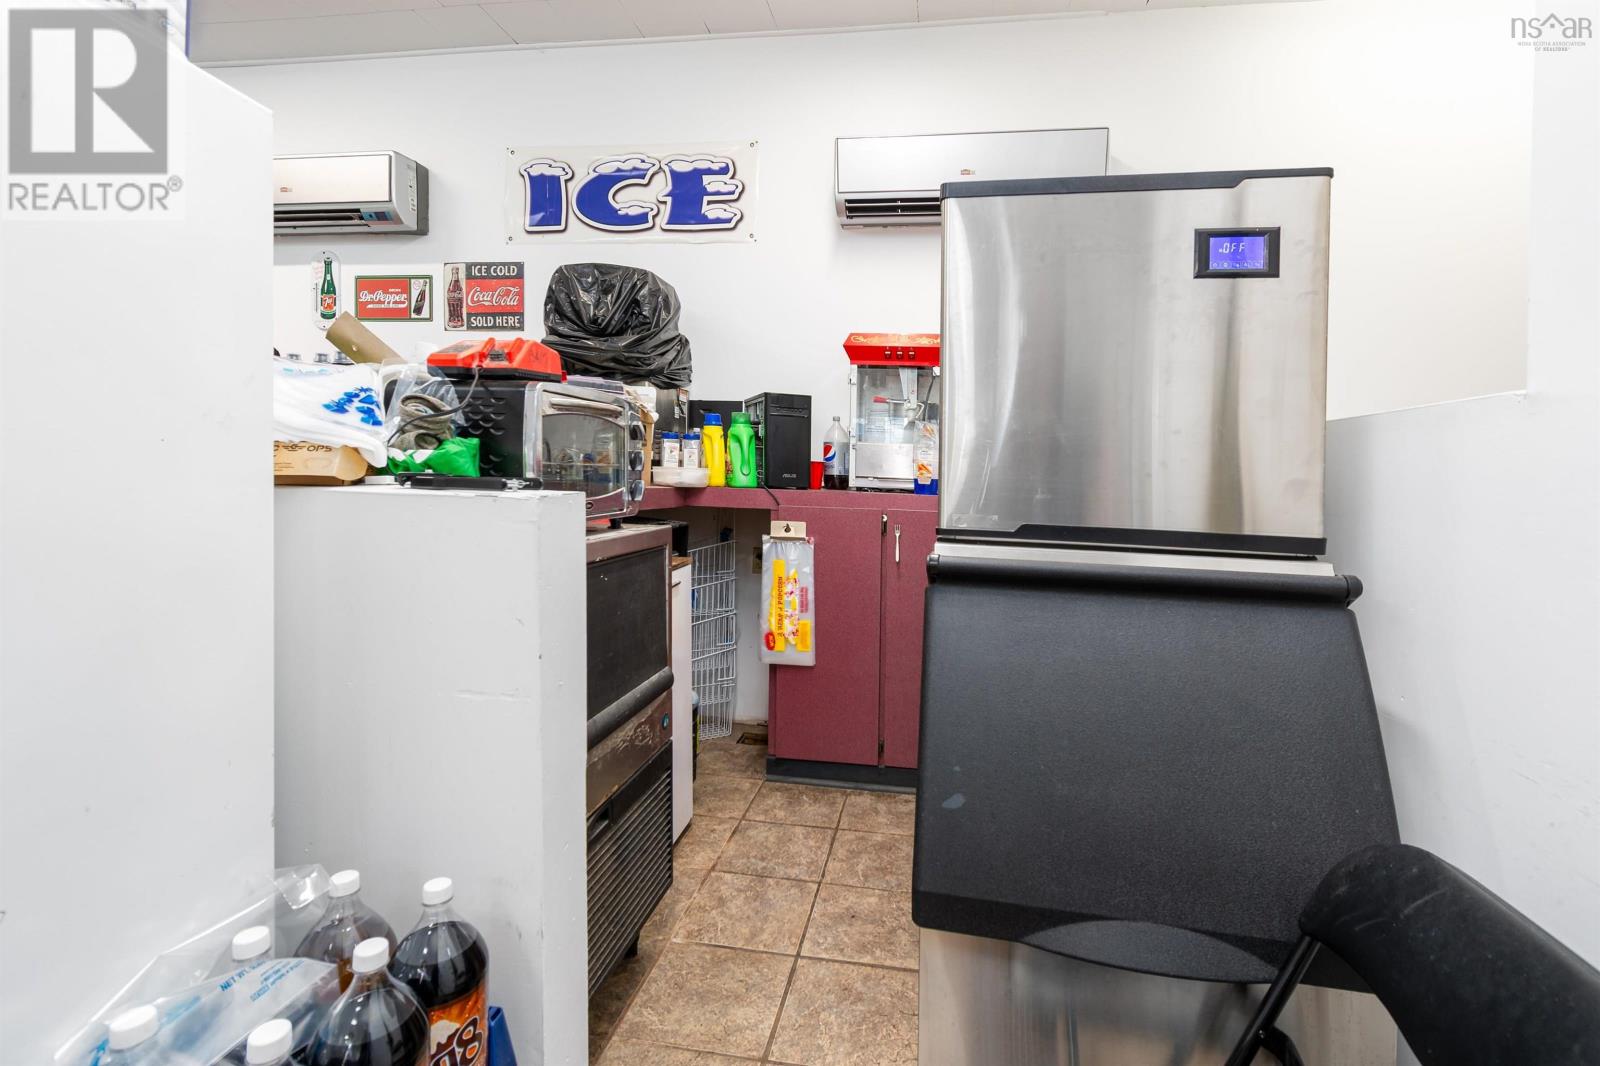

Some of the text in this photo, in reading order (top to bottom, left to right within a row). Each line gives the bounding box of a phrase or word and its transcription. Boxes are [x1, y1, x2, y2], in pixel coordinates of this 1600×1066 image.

[518, 153, 745, 233] ICE
[1222, 242, 1246, 253] OFF
[471, 265, 517, 276] ICE COLD
[470, 316, 521, 327] SOLD HERE
[776, 576, 784, 605] POPCORN
[219, 976, 237, 991] NET
